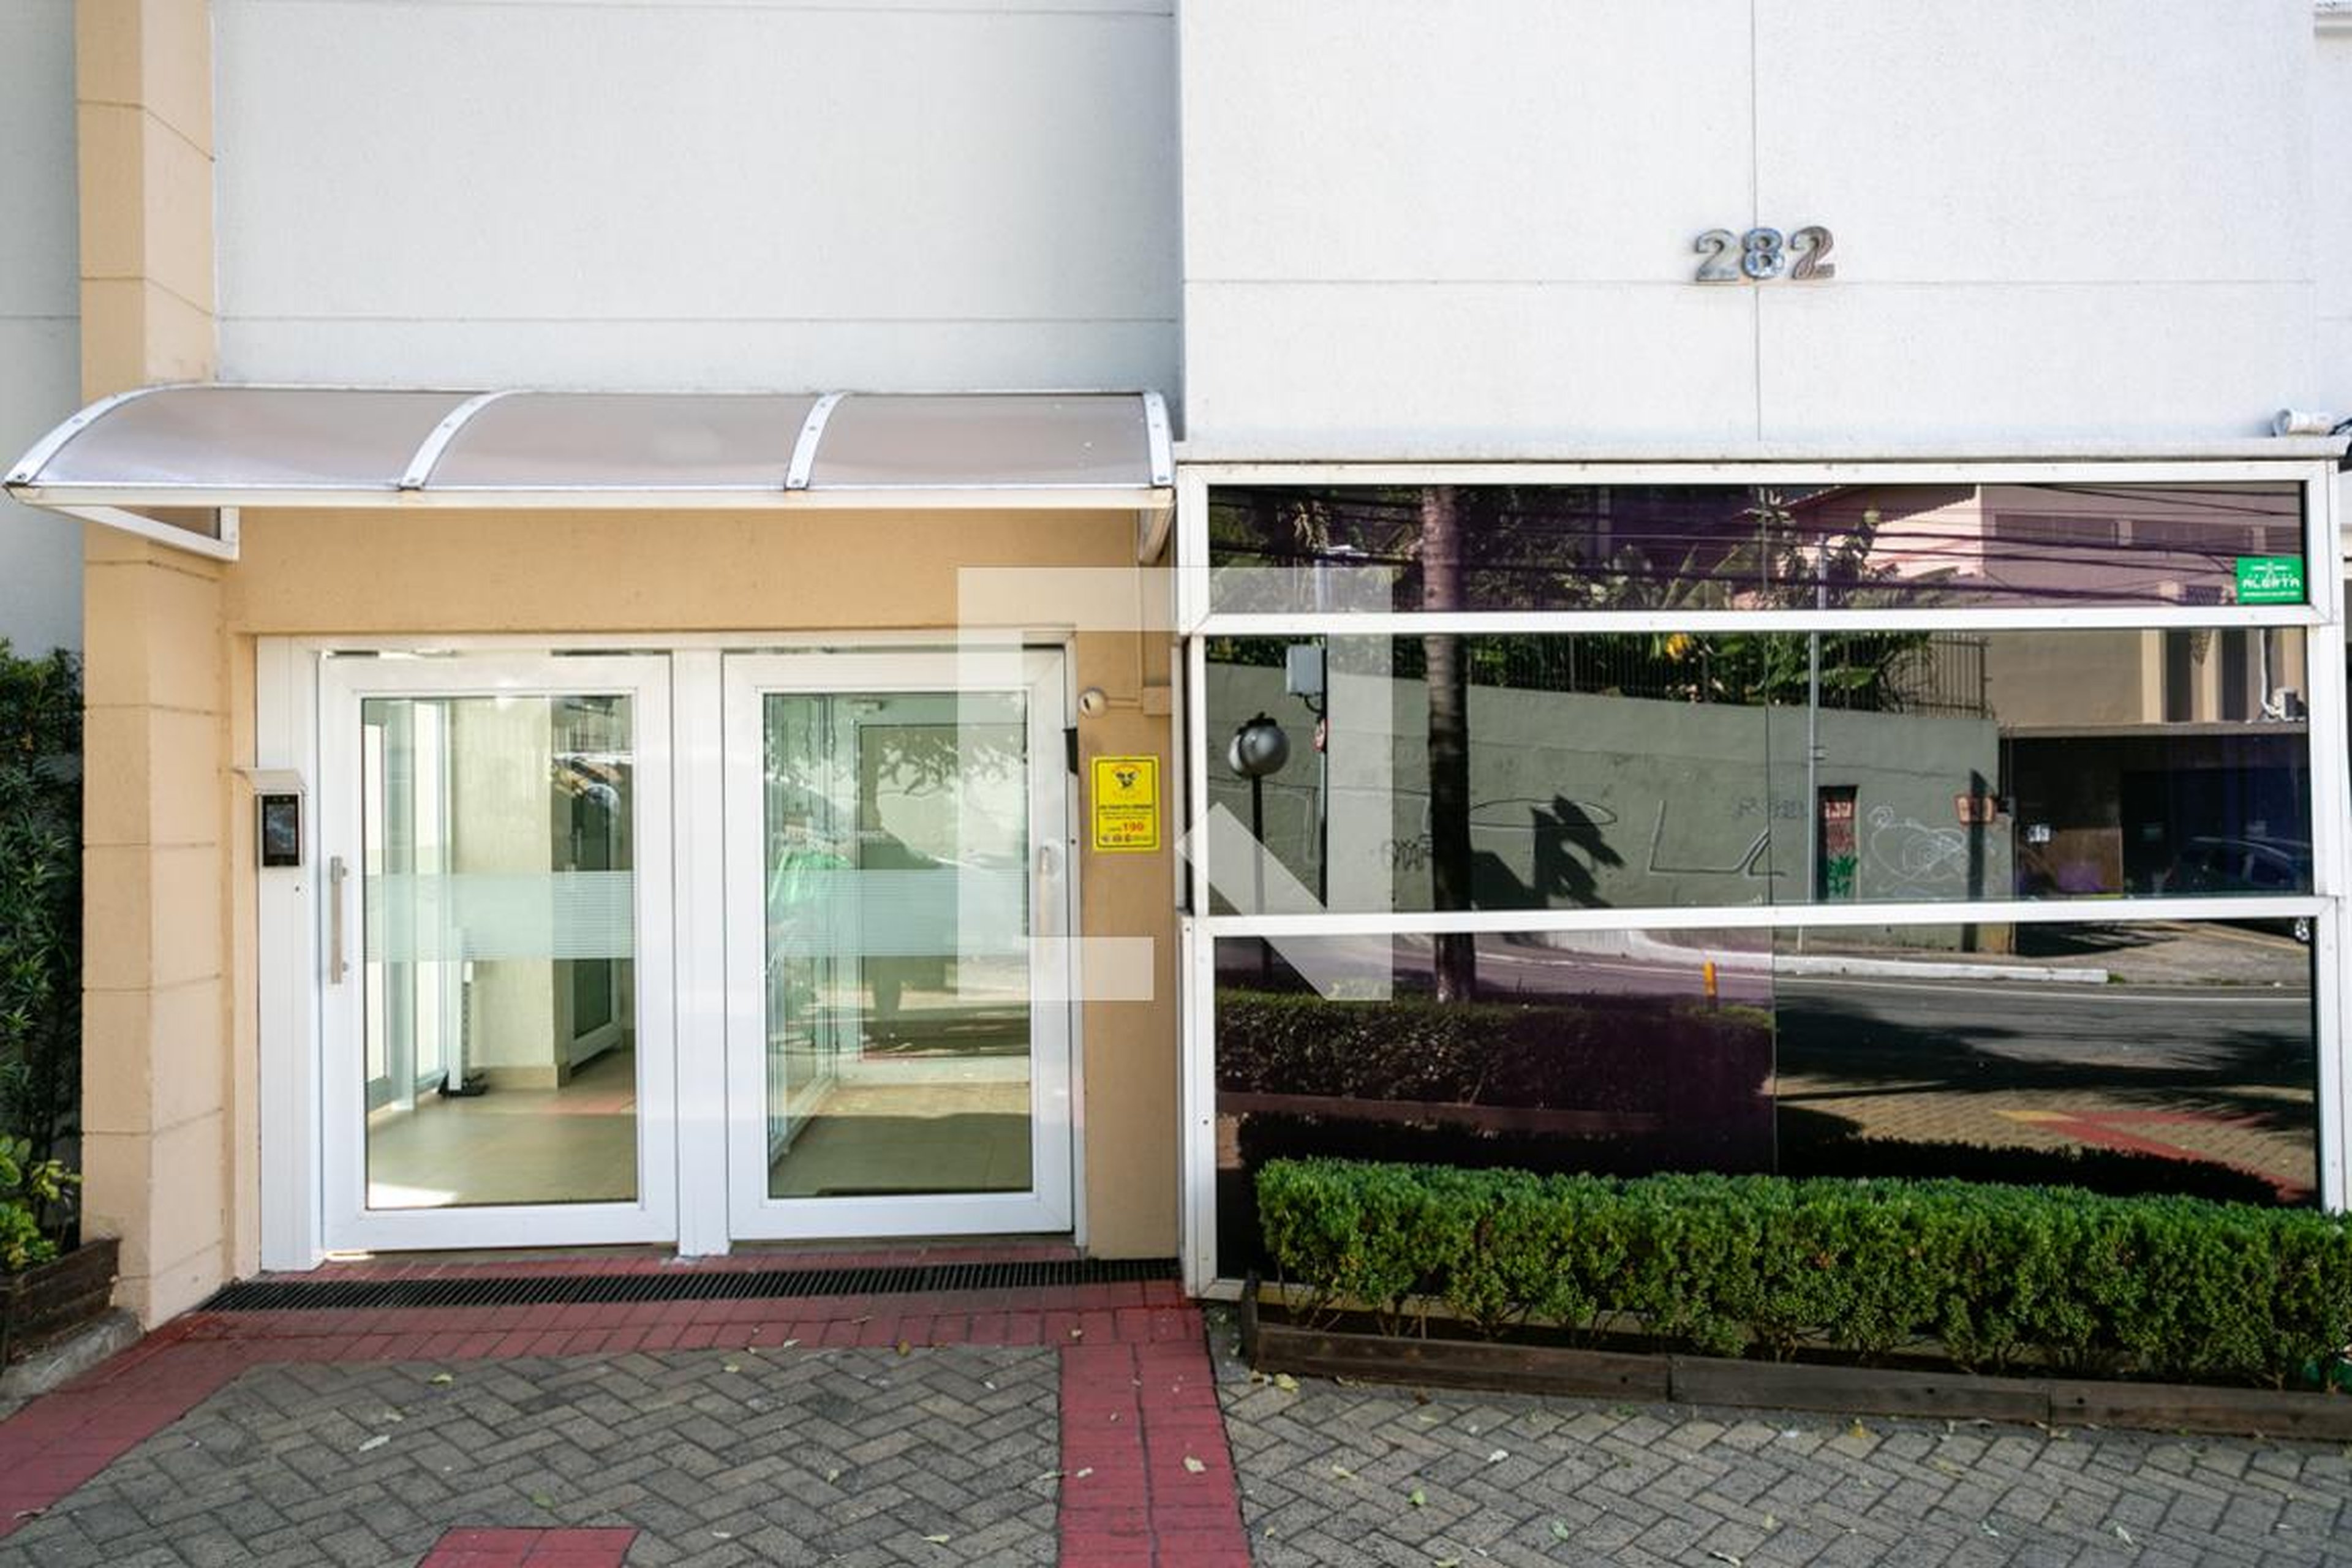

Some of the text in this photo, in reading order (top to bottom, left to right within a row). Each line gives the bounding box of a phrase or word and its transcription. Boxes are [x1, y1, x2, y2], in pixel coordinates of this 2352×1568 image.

[1694, 225, 1835, 281] 282
[2242, 578, 2299, 588] ALERTA
[1123, 821, 1144, 832] 190
